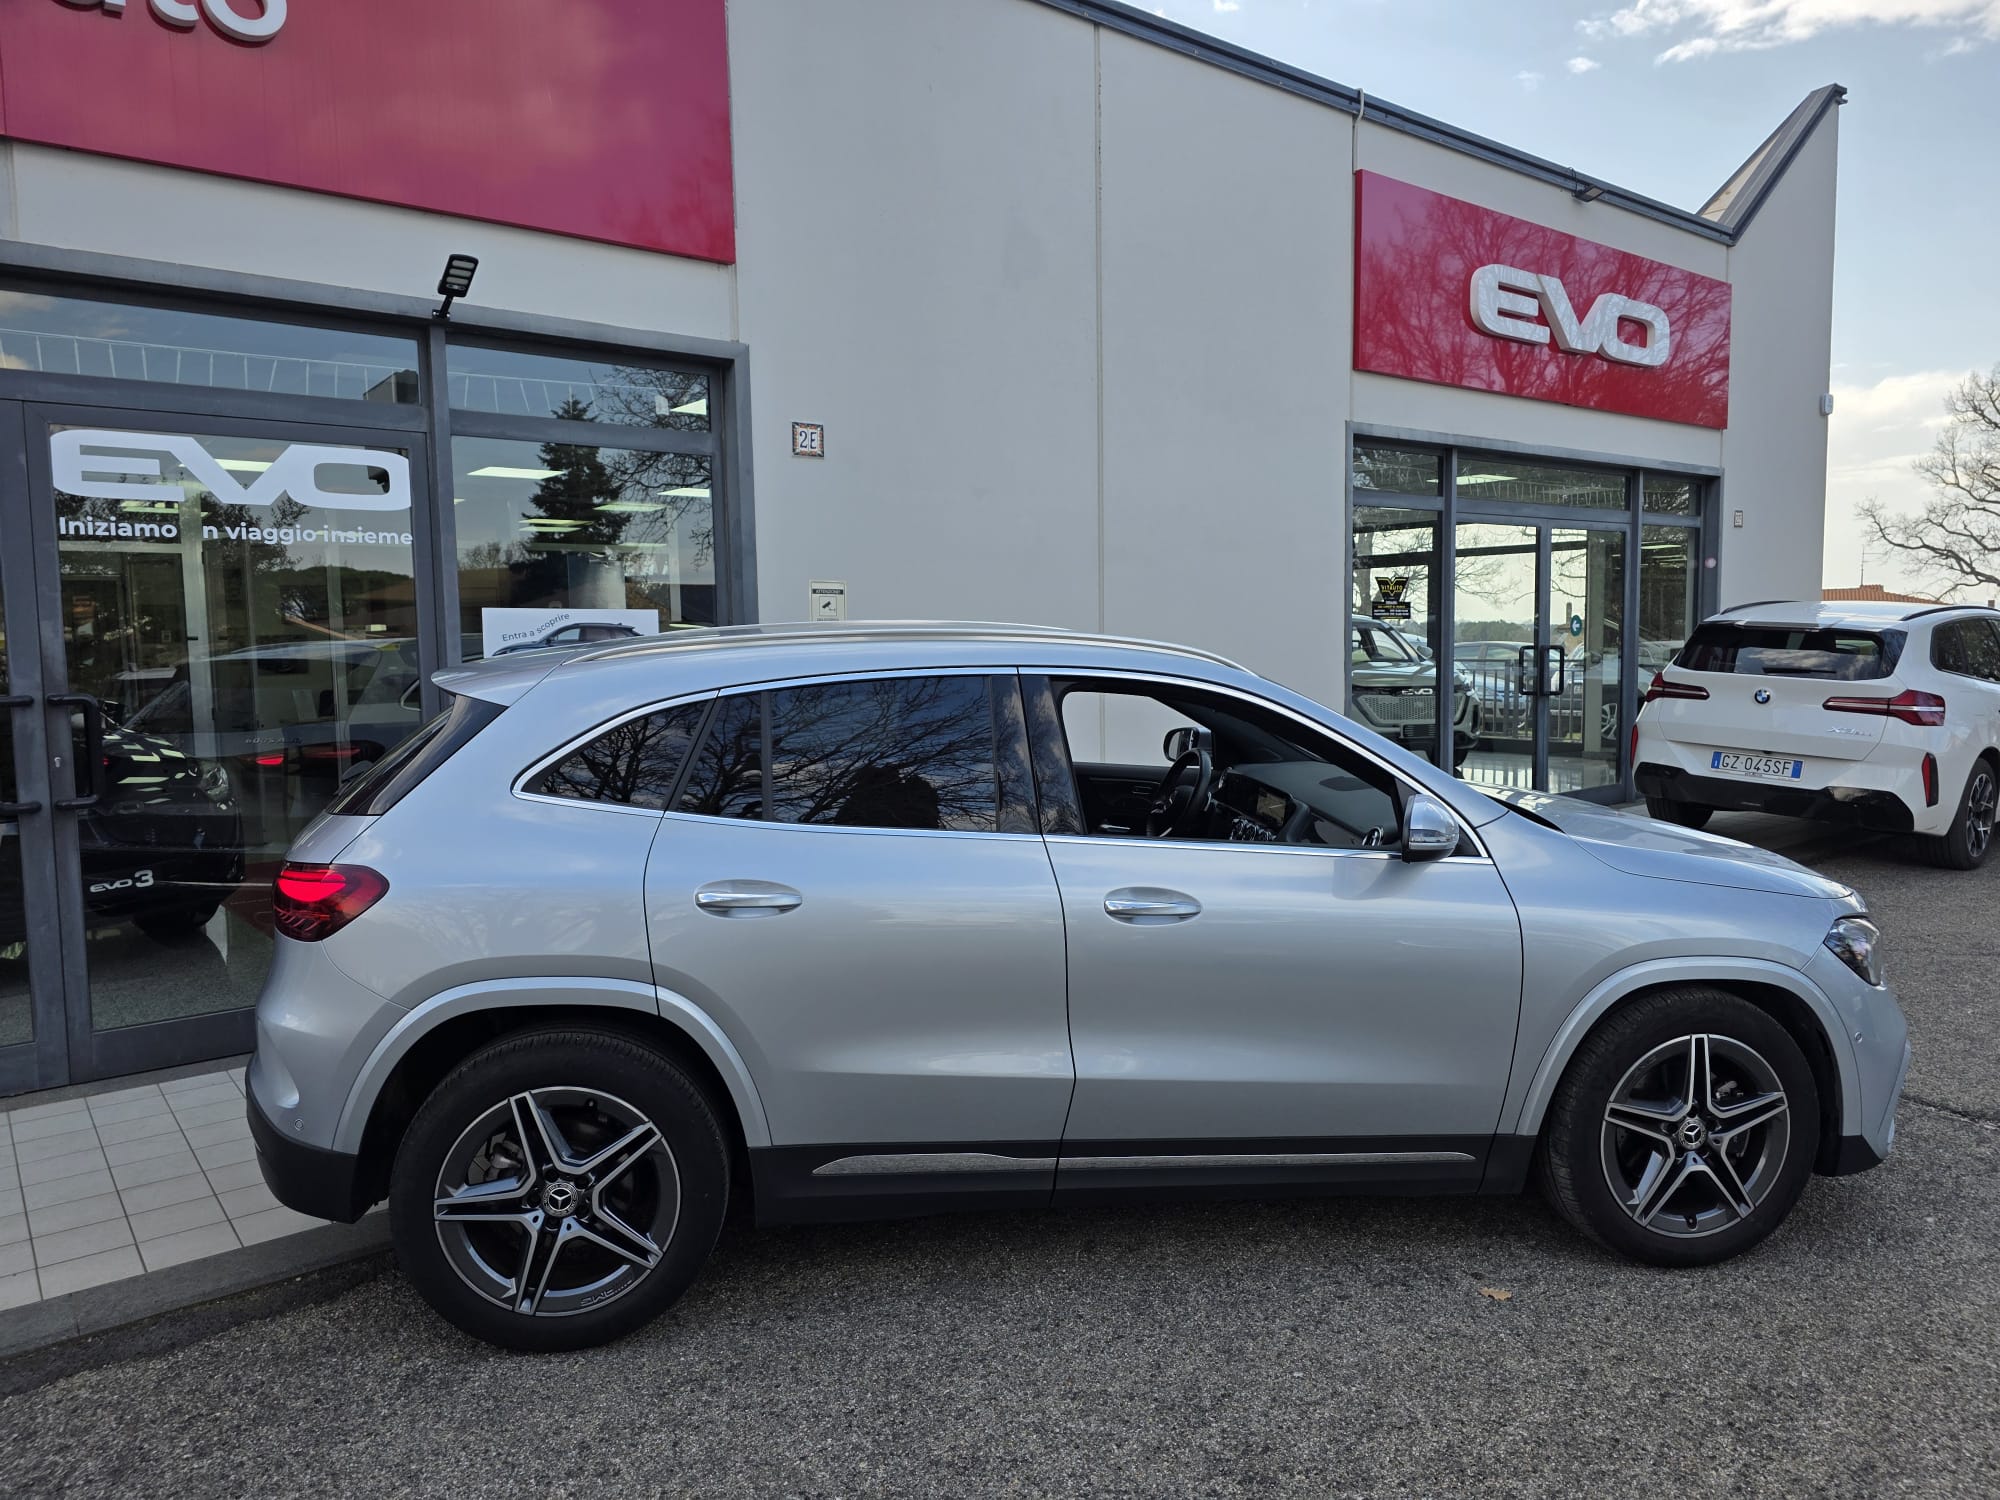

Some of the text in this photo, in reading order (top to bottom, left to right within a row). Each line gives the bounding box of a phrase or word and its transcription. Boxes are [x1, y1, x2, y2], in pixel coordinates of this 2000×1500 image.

[1470, 264, 1670, 367] EVO
[50, 429, 412, 511] EVO
[58, 516, 178, 539] Iniziamo
[224, 521, 316, 545] viaggio
[323, 524, 413, 545] insieme
[502, 632, 527, 642] Entra
[536, 613, 570, 634] scoprire
[1721, 754, 1738, 770] GZ
[1744, 758, 1792, 775] 045SF
[89, 869, 154, 893] EVO 3
